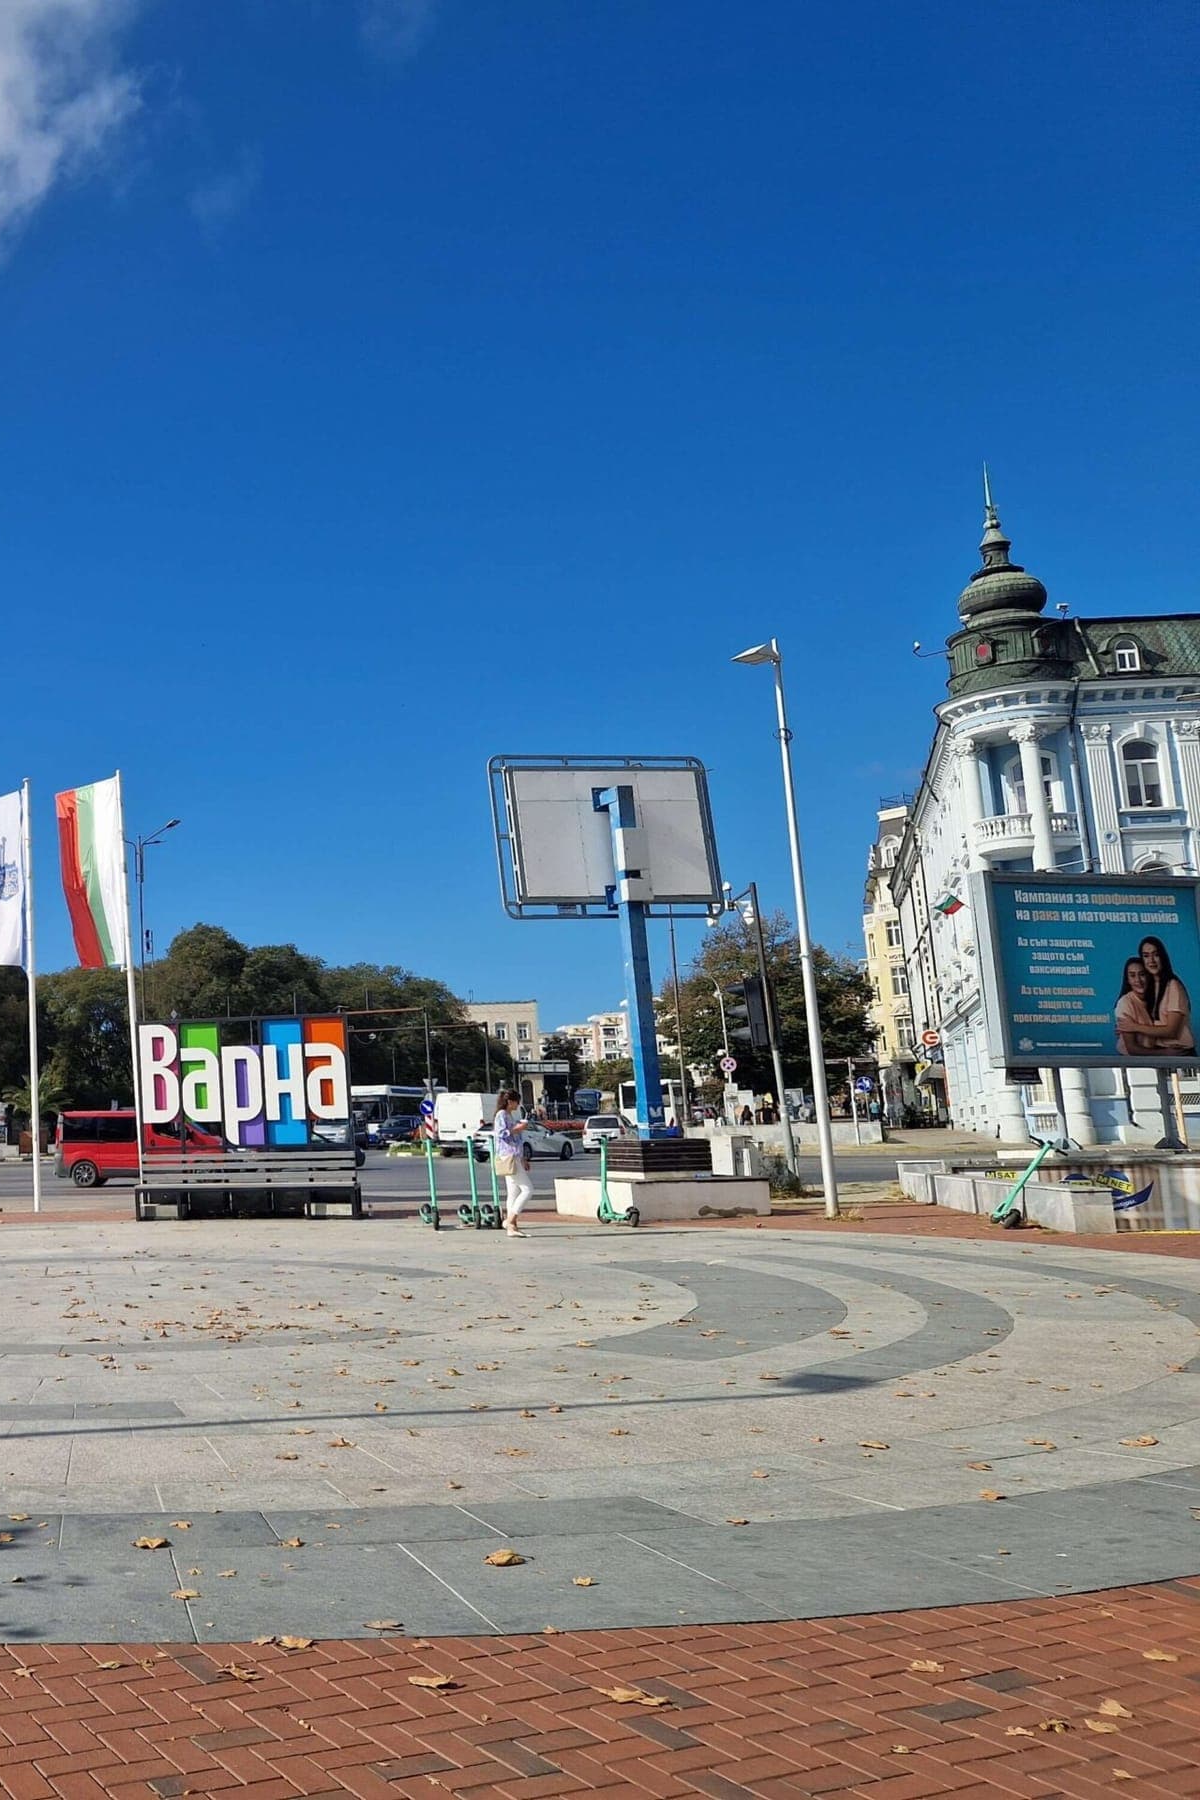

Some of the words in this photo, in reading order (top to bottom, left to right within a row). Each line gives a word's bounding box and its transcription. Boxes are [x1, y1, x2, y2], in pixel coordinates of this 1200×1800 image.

[1014, 890, 1073, 904] Кампания
[1075, 893, 1089, 904] за
[1090, 892, 1176, 906] профилактика
[1015, 909, 1030, 921] на
[1032, 910, 1060, 922] рака
[1061, 911, 1076, 922] на
[1078, 911, 1139, 922] маточната
[1140, 910, 1179, 923] шийка
[1017, 937, 1028, 947] Аз
[1029, 938, 1048, 947] съм
[1032, 952, 1065, 961] защото
[1066, 953, 1085, 961] съм
[1029, 965, 1090, 975] ваксинирана!
[1021, 985, 1032, 995] Аз
[1033, 986, 1052, 996] съм
[1038, 1001, 1071, 1010] защото
[139, 1024, 349, 1145] Варна
[997, 1171, 1016, 1179] SAT
[1110, 1178, 1132, 1191] NET
